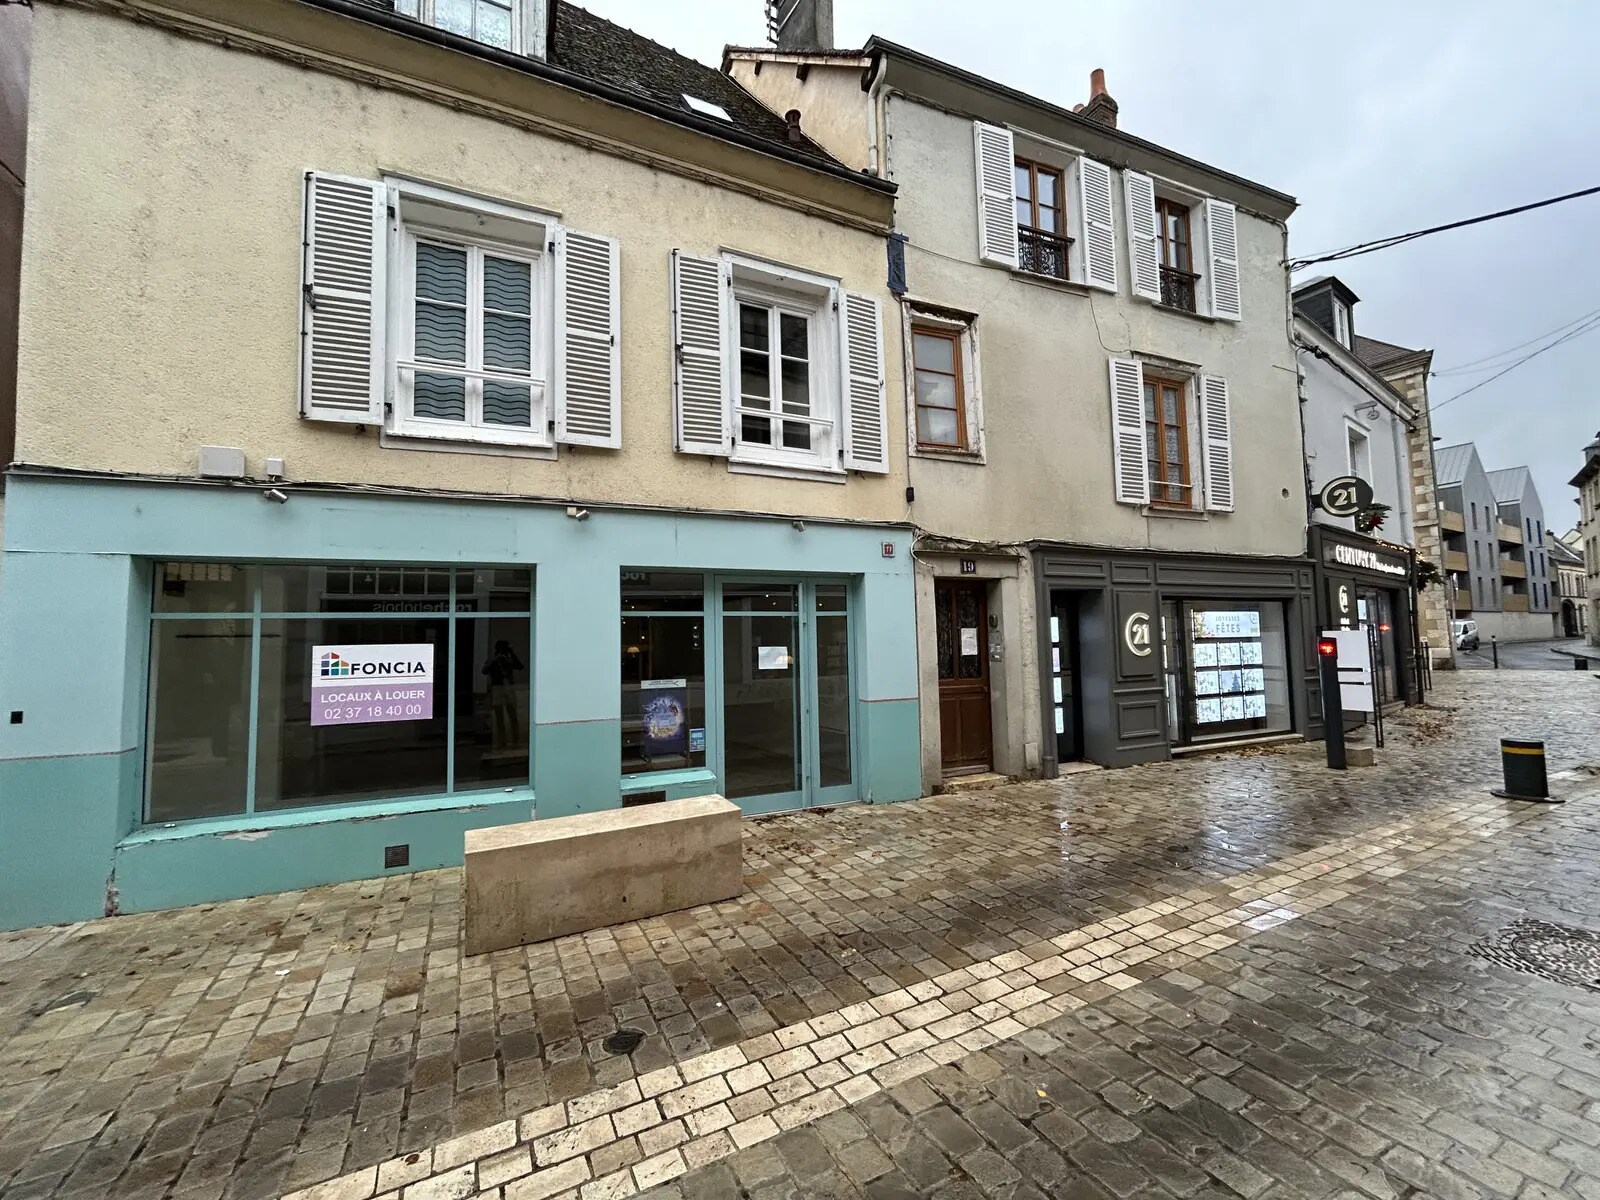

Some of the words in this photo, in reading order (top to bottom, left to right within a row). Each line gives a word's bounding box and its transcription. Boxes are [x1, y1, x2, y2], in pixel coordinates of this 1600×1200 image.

[962, 561, 975, 572] 19
[1215, 621, 1240, 633] FÊTES
[350, 661, 426, 675] FONCIA
[321, 692, 372, 703] LOCAUX
[374, 690, 384, 701] À
[386, 690, 426, 700] LOUER
[324, 708, 341, 719] 02
[345, 707, 362, 718] 37
[367, 706, 382, 717] 18
[386, 705, 402, 716] 40
[405, 704, 422, 715] 00
